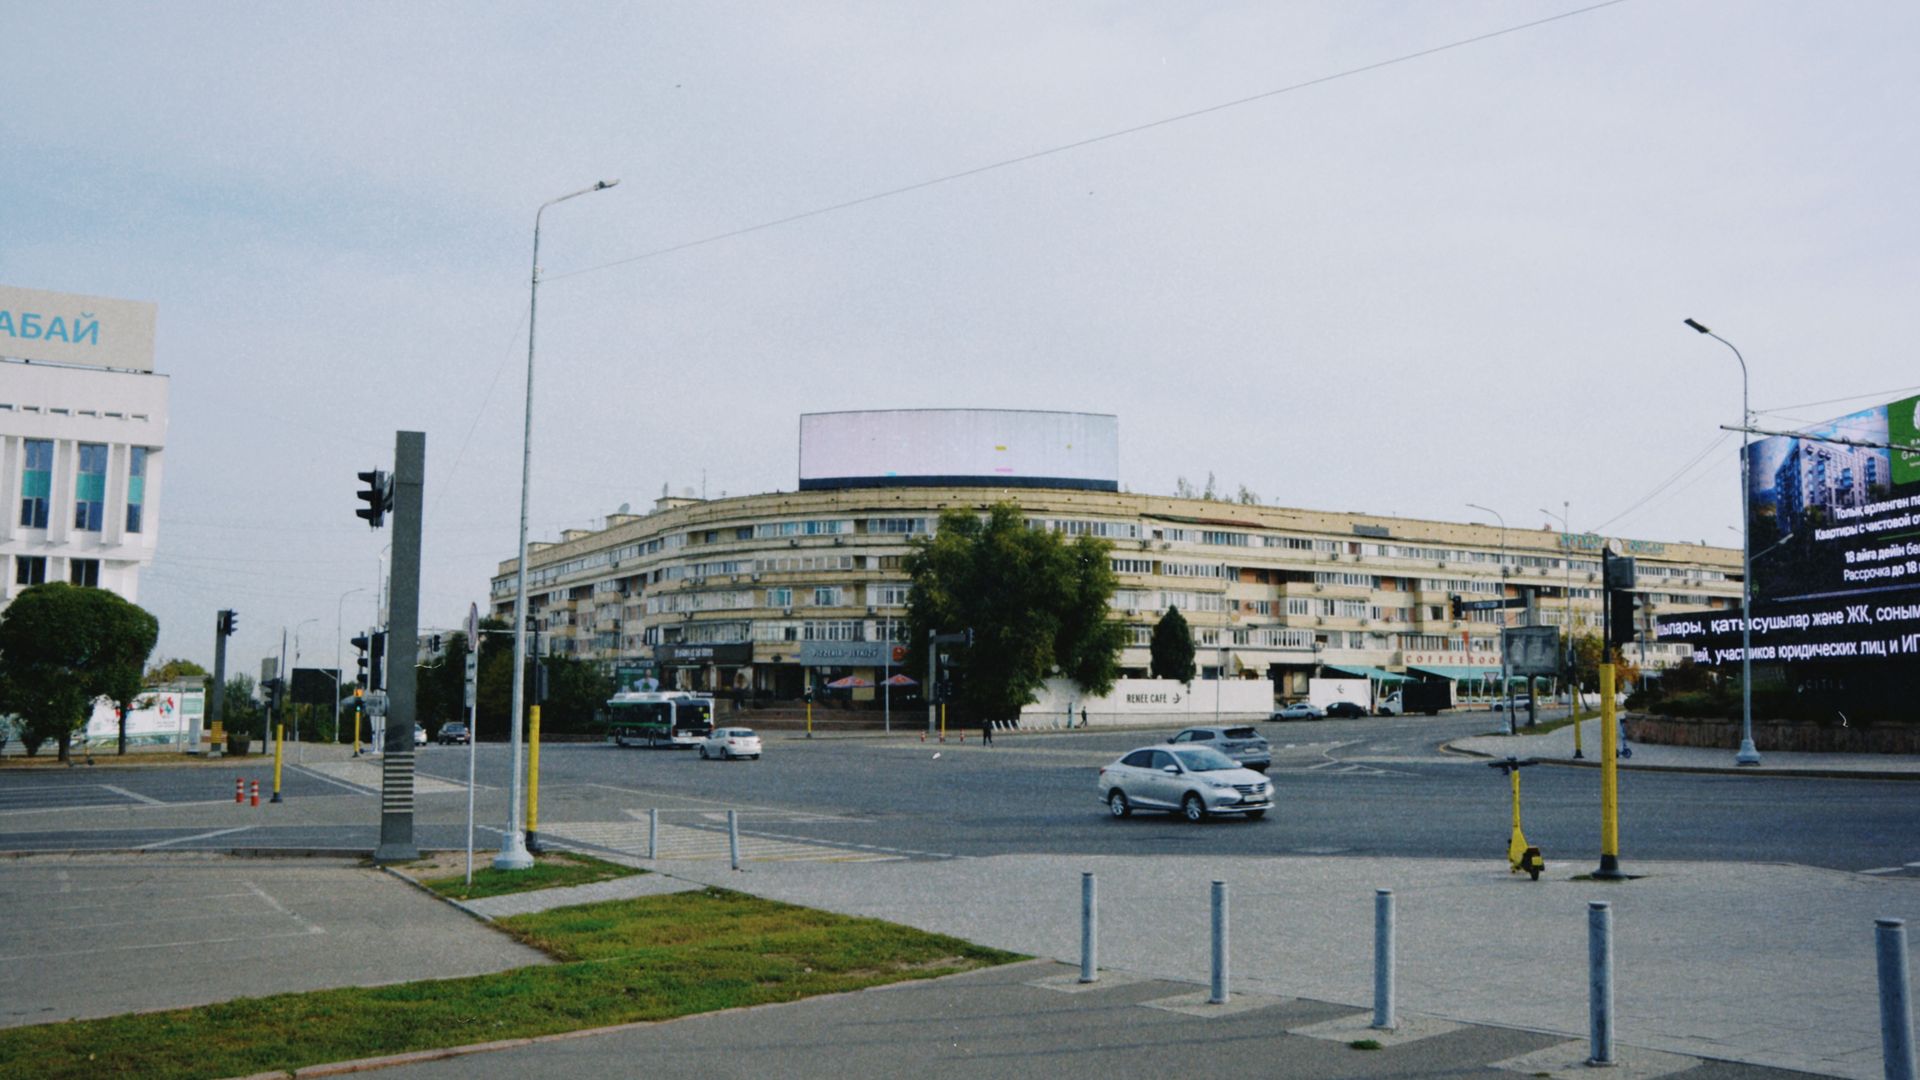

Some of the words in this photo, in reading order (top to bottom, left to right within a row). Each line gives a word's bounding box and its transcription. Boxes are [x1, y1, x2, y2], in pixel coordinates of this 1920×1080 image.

[1815, 525, 1858, 540] Квартиры
[1859, 524, 1865, 533] с
[1866, 513, 1910, 532] чистовой
[1845, 551, 1855, 563] 18
[1843, 566, 1891, 581] Рассрочка
[1891, 565, 1904, 578] до
[1905, 561, 1917, 574] 18
[1711, 614, 1810, 635] қатысушылар
[1812, 611, 1844, 626] және
[1846, 604, 1873, 624] ЖК,
[1779, 642, 1857, 662] юридических
[1860, 640, 1887, 657] лиц
[1889, 640, 1898, 653] и
